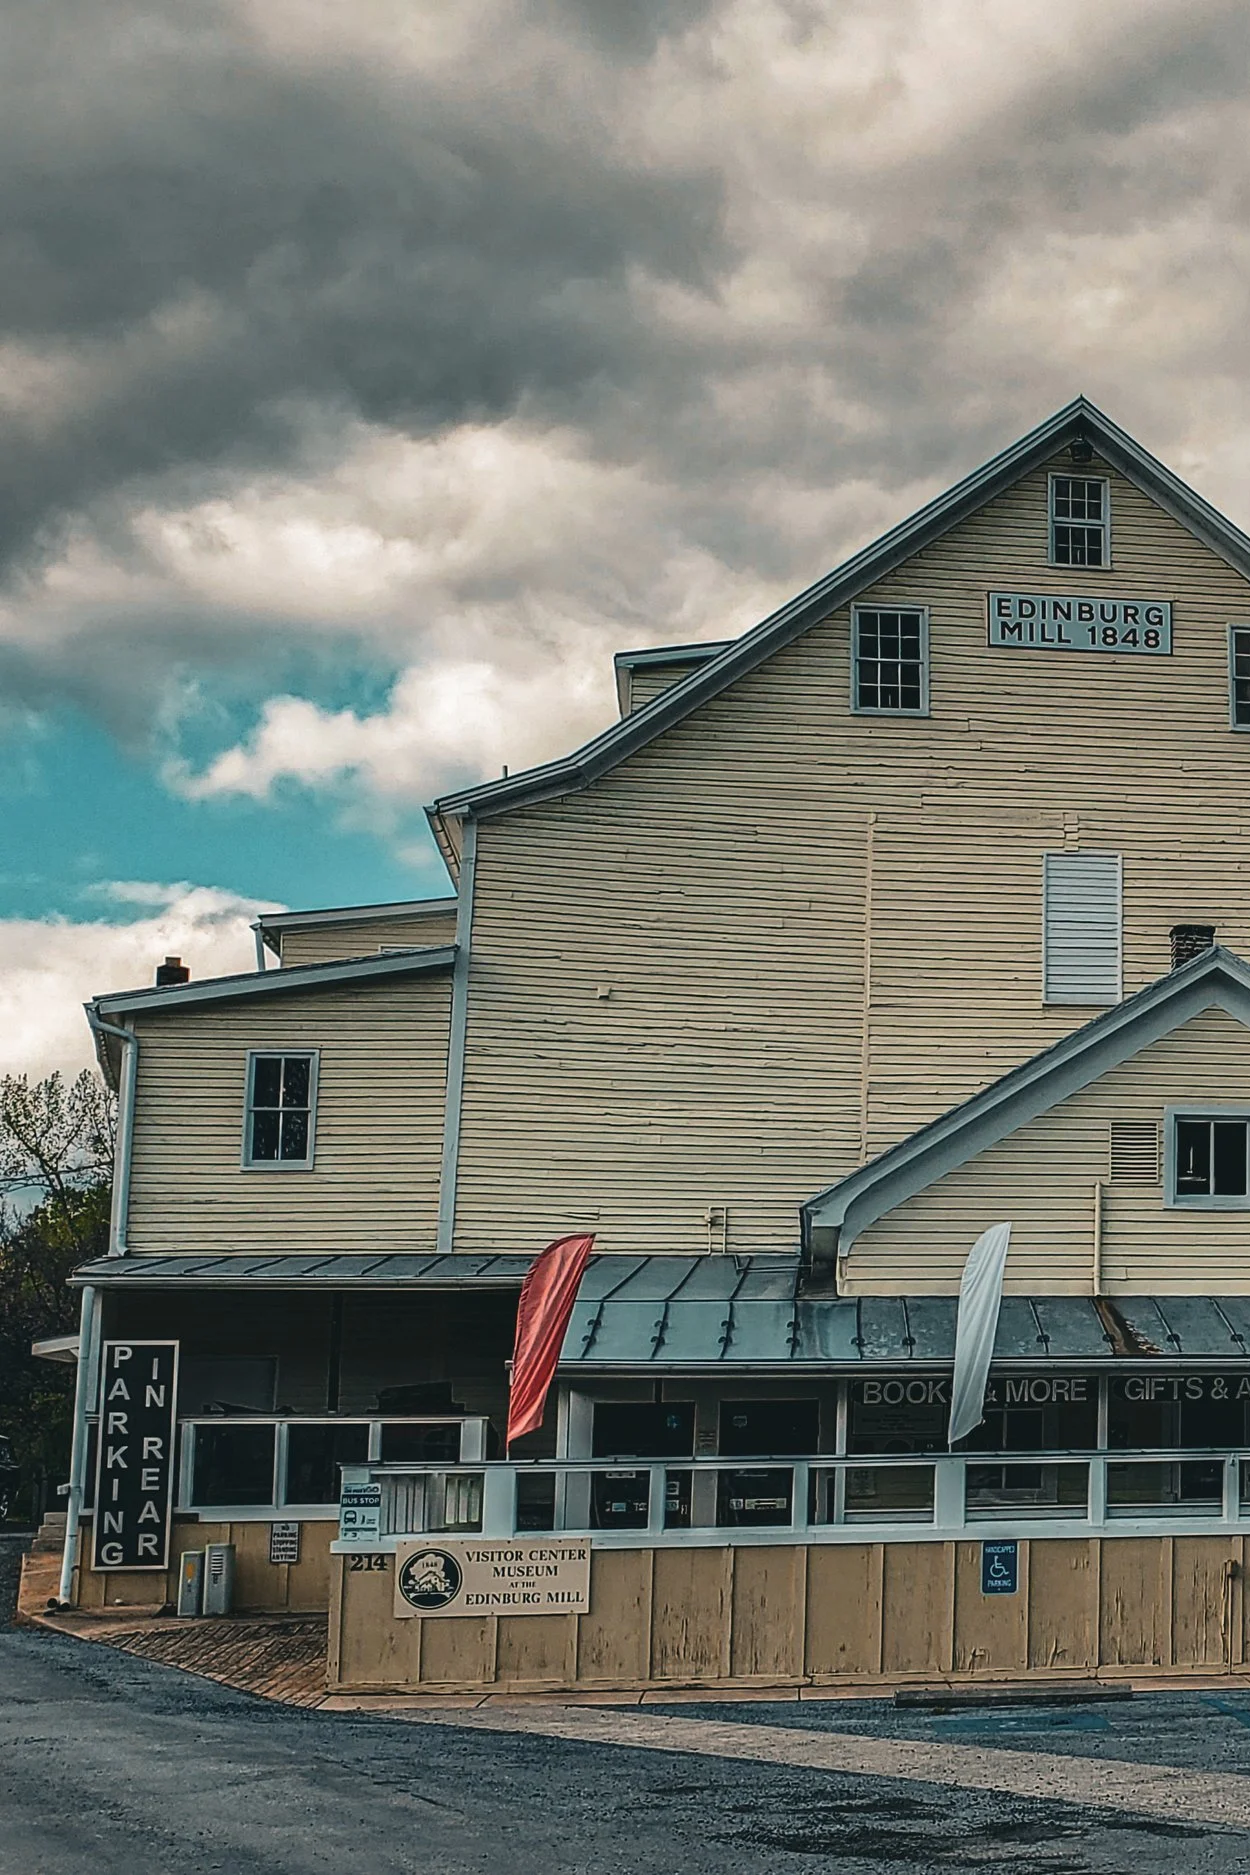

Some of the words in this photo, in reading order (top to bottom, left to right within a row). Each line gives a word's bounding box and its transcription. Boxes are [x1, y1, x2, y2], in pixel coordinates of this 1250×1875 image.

[996, 597, 1164, 627] EDINBURG
[1000, 620, 1072, 645] MILL
[1087, 625, 1161, 649] 1848
[145, 1357, 165, 1408] IN
[863, 1380, 953, 1405] BOOK
[1006, 1379, 1088, 1403] MORE
[1124, 1377, 1204, 1401] GIFTS
[1210, 1377, 1229, 1400] &
[101, 1346, 133, 1565] PARKING
[137, 1436, 164, 1556] REAR
[350, 1555, 388, 1572] 214
[465, 1550, 523, 1563] VISITOR
[529, 1549, 587, 1562] CENTER
[493, 1566, 558, 1578] MUSEUM
[465, 1593, 541, 1606] EDINBURG
[547, 1592, 584, 1604] MILL
